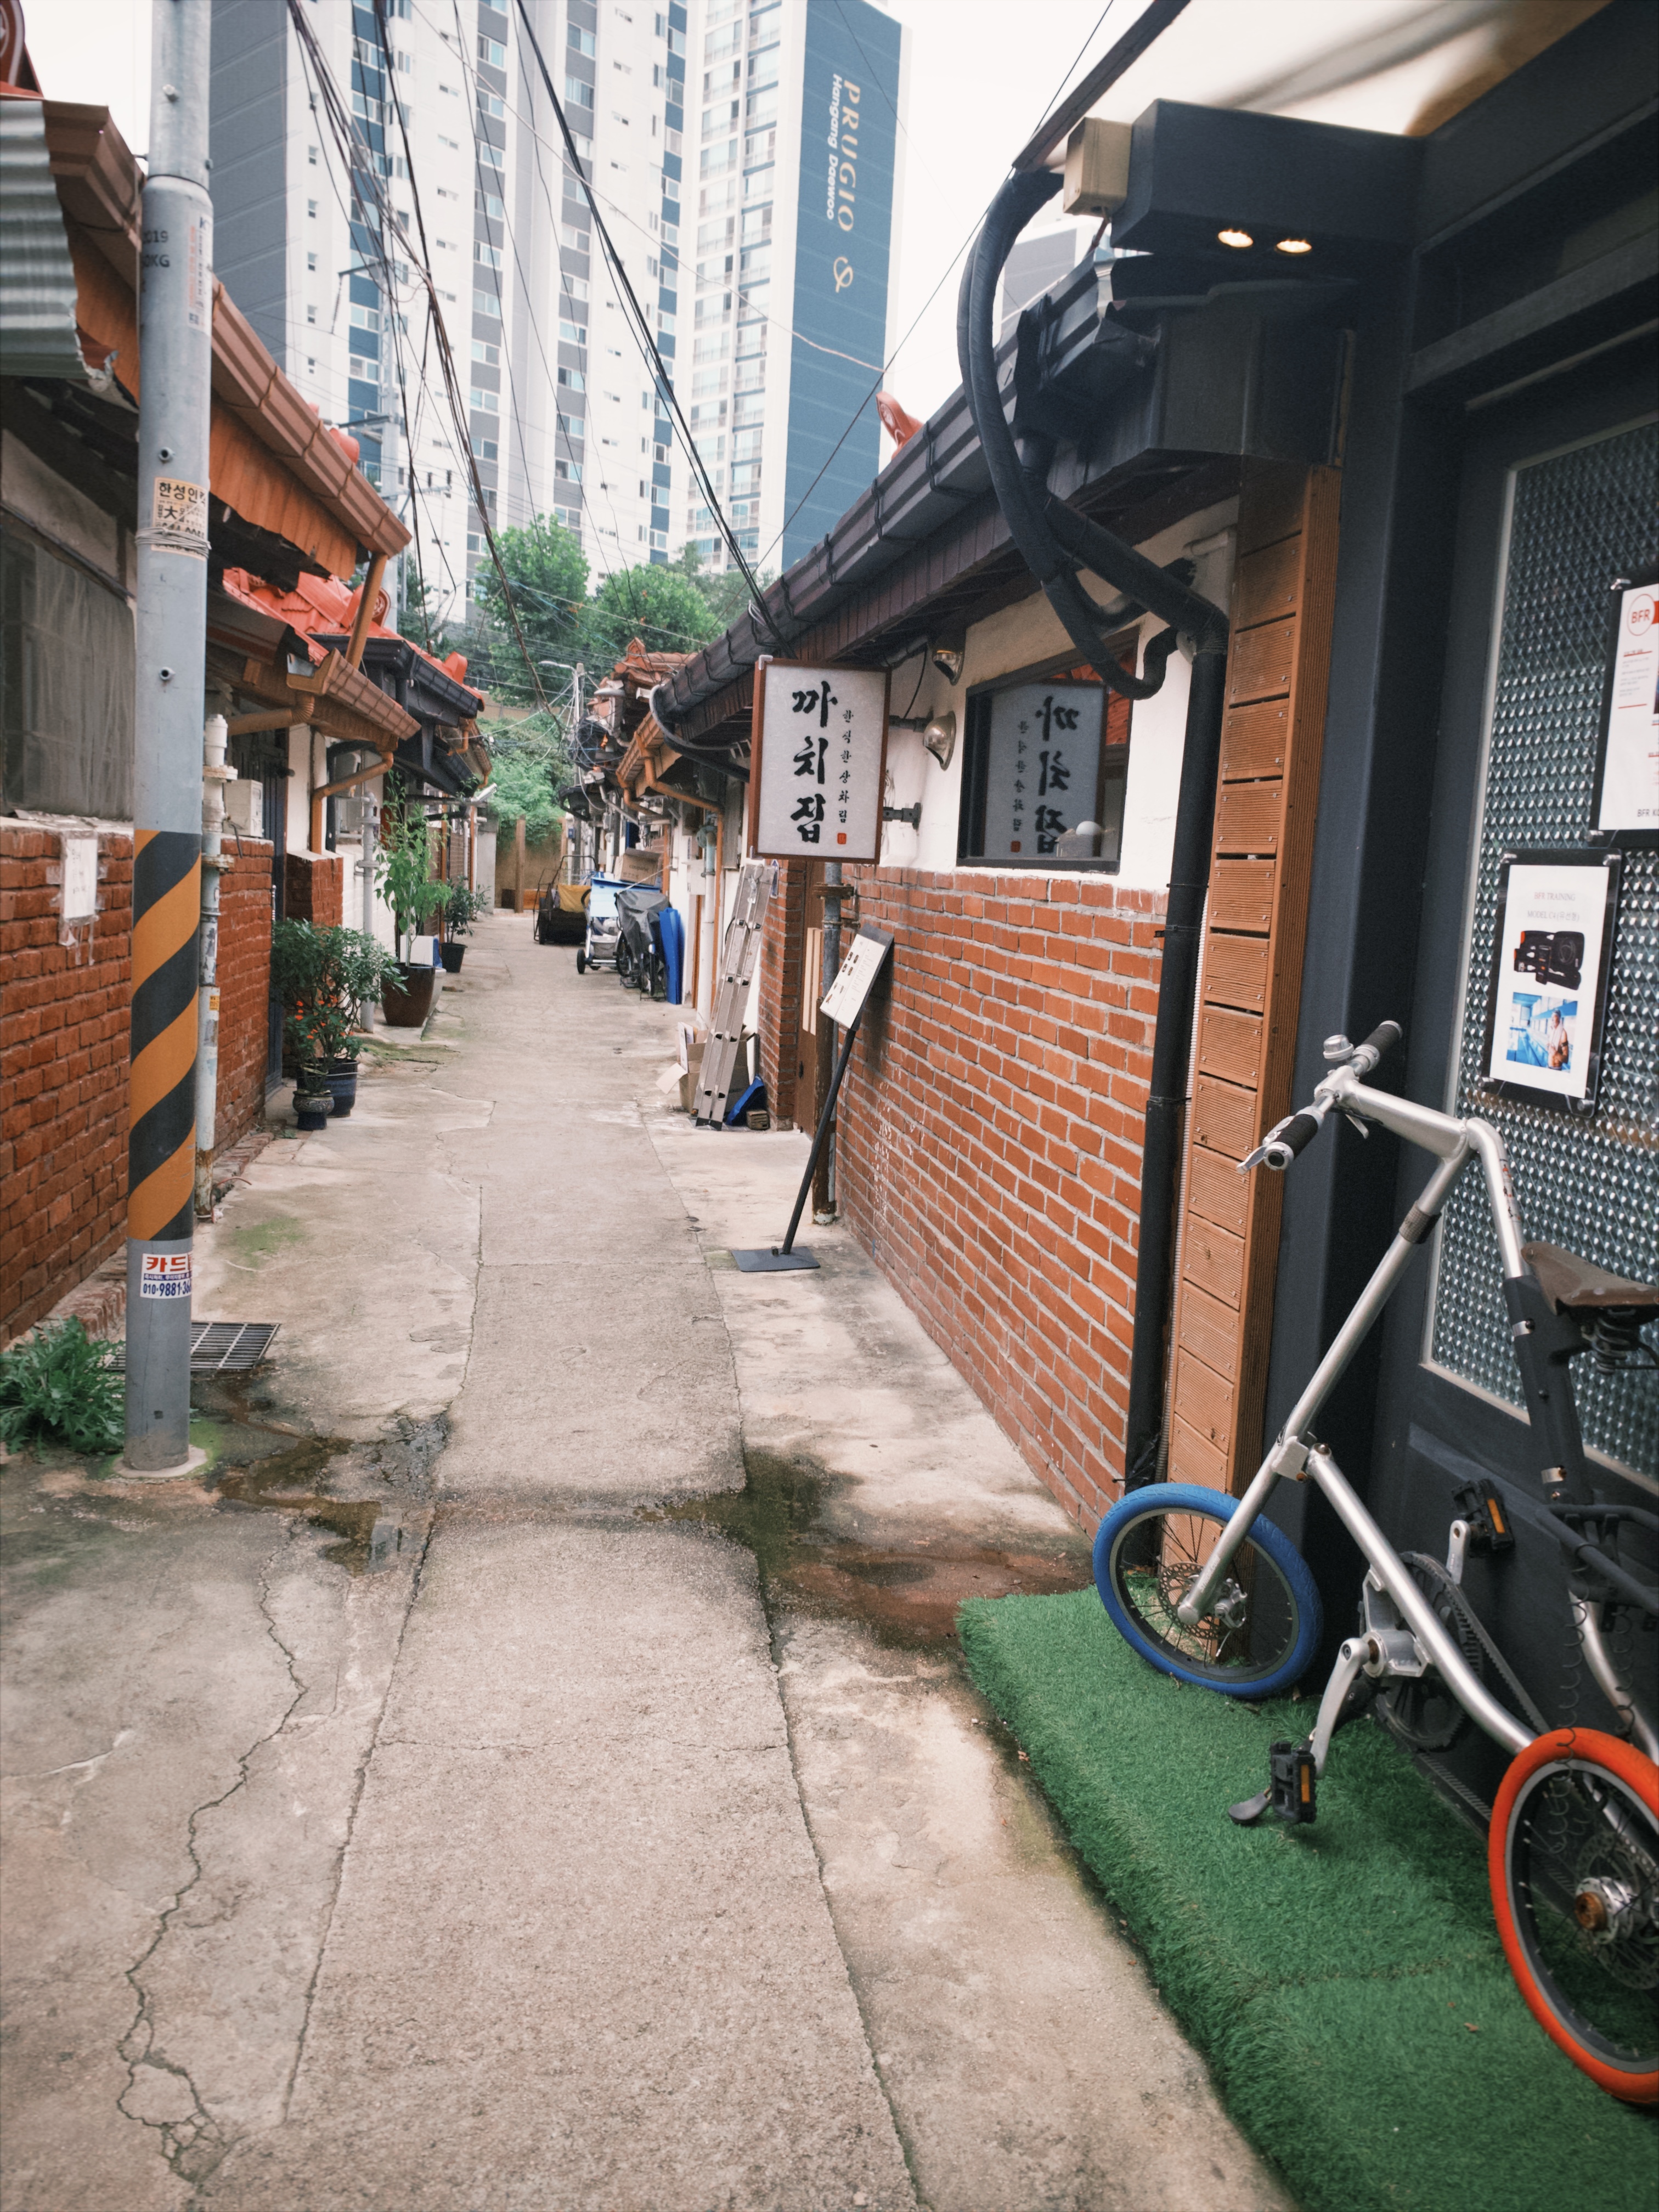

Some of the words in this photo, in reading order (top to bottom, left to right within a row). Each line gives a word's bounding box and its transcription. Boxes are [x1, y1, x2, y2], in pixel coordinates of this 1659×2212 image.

[827, 74, 843, 149] Hangang
[826, 154, 838, 220] Daewoo
[837, 80, 860, 232] PRUGIO
[1631, 609, 1650, 624] BFR
[791, 680, 838, 844] 까치집
[1527, 910, 1548, 918] MODEL
[146, 1256, 187, 1272] 카드
